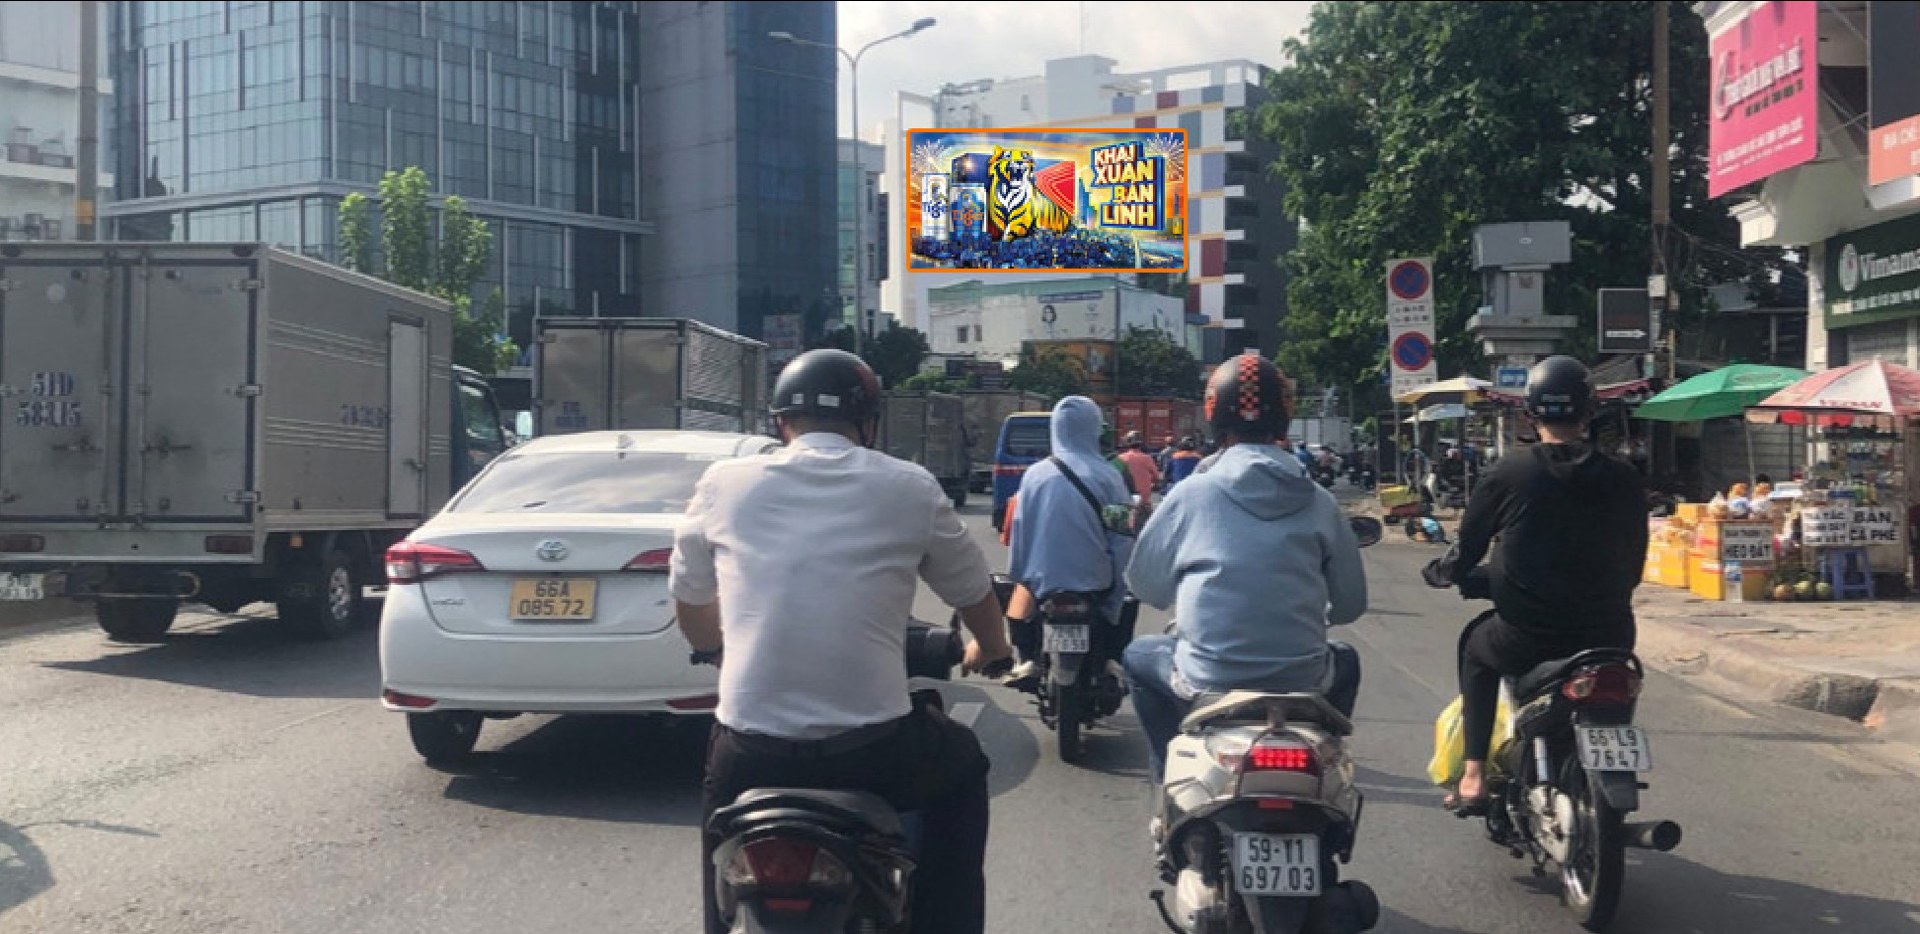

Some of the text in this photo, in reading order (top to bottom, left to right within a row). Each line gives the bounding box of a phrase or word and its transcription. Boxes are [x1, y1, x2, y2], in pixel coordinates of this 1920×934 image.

[535, 581, 570, 597] 66A
[519, 599, 585, 616] 085.72
[1241, 866, 1315, 891] 697.03
